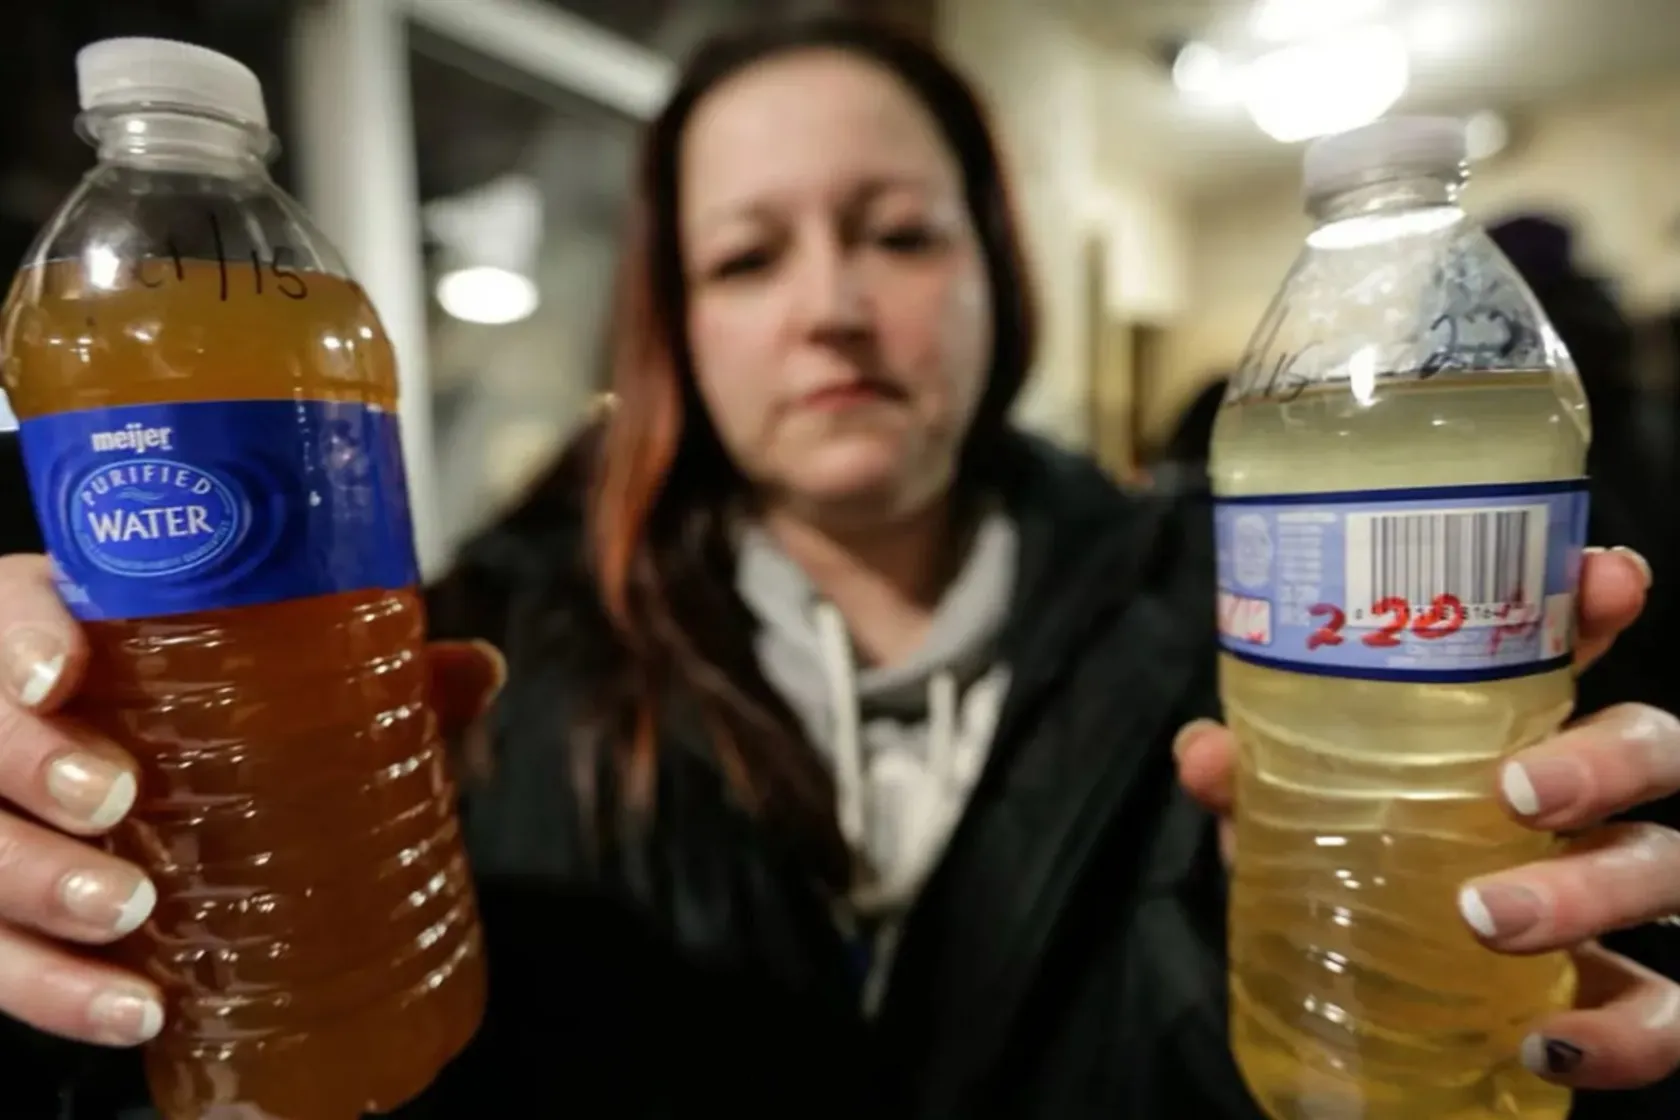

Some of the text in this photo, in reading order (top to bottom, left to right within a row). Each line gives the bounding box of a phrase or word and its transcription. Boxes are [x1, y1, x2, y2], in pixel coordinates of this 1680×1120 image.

[91, 422, 172, 454] meijer
[81, 463, 213, 507] PURIFIED
[87, 504, 214, 543] WATER
